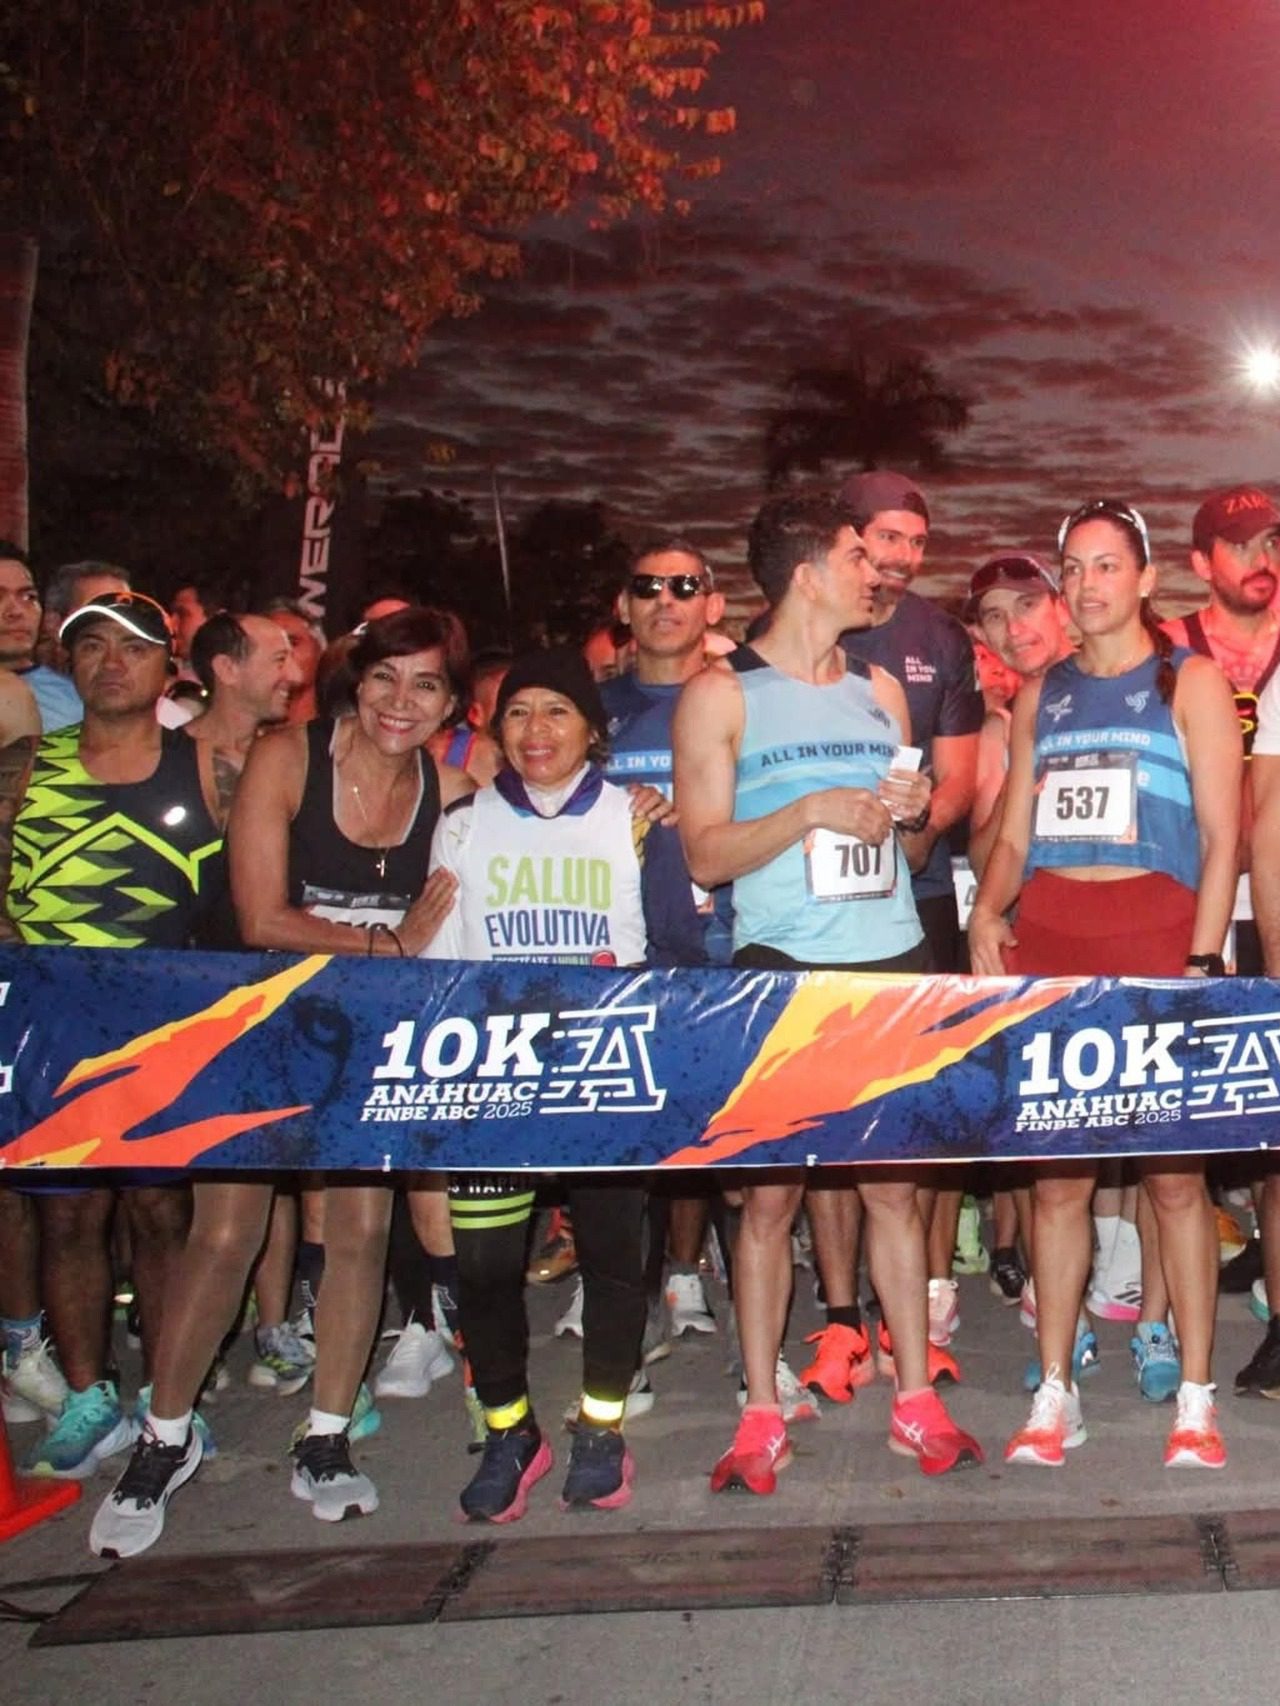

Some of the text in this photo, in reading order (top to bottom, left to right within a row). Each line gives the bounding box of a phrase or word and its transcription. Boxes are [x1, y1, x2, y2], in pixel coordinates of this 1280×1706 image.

[761, 742, 897, 767] ALL IN YOUR MIN
[1056, 735, 1072, 747] IN
[1076, 732, 1109, 746] YOUR
[1111, 732, 1151, 746] MIND
[1056, 786, 1110, 820] 537
[834, 844, 881, 877] 707
[485, 855, 612, 911] SALUD
[484, 909, 611, 948] EVOLUTIVA
[372, 1013, 551, 1079] 10K
[1019, 1022, 1185, 1096] 10K
[367, 1079, 539, 1106] ANÁHUAC
[1017, 1090, 1184, 1121] ANÁHUAC
[361, 1101, 534, 1122] FINBE ABC 2025
[1015, 1110, 1182, 1132] FINBE ABC 2025
